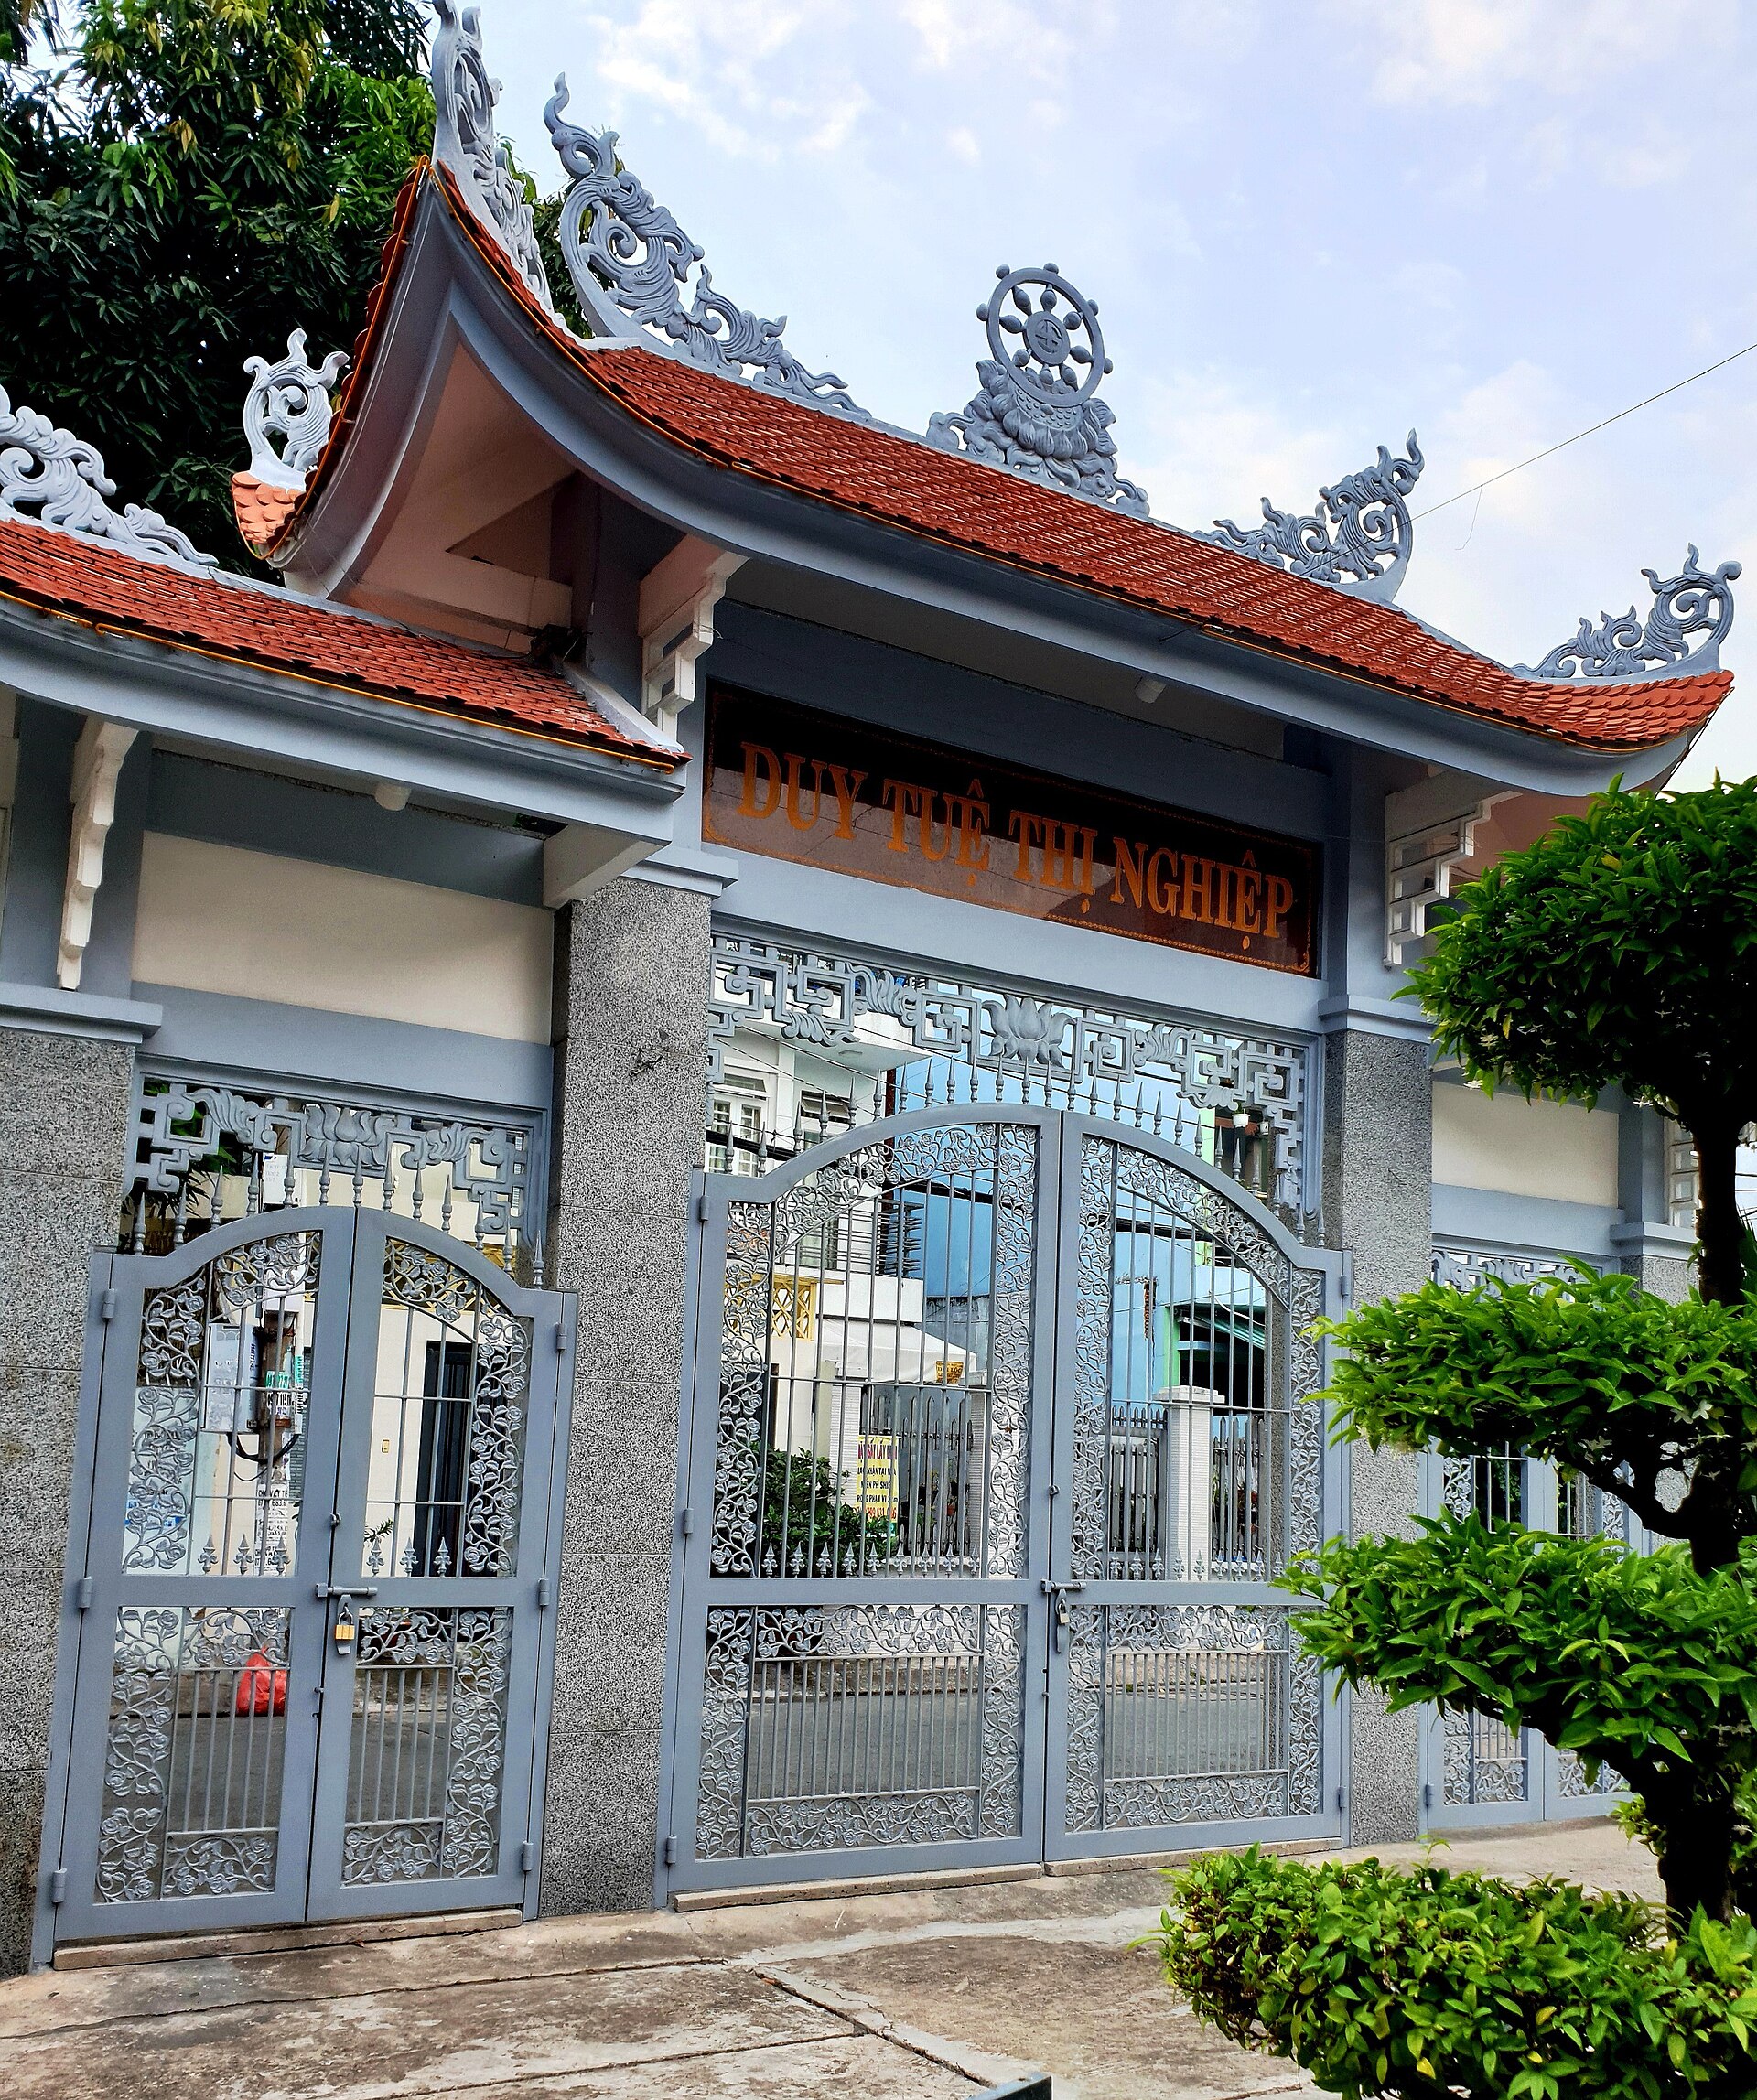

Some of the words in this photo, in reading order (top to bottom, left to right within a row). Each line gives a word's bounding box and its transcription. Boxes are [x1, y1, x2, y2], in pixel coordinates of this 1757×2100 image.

[737, 742, 867, 840] DUY
[881, 779, 991, 886] TUỆ
[1008, 810, 1098, 914] THỊ
[1110, 837, 1294, 951] NGHIỆP
